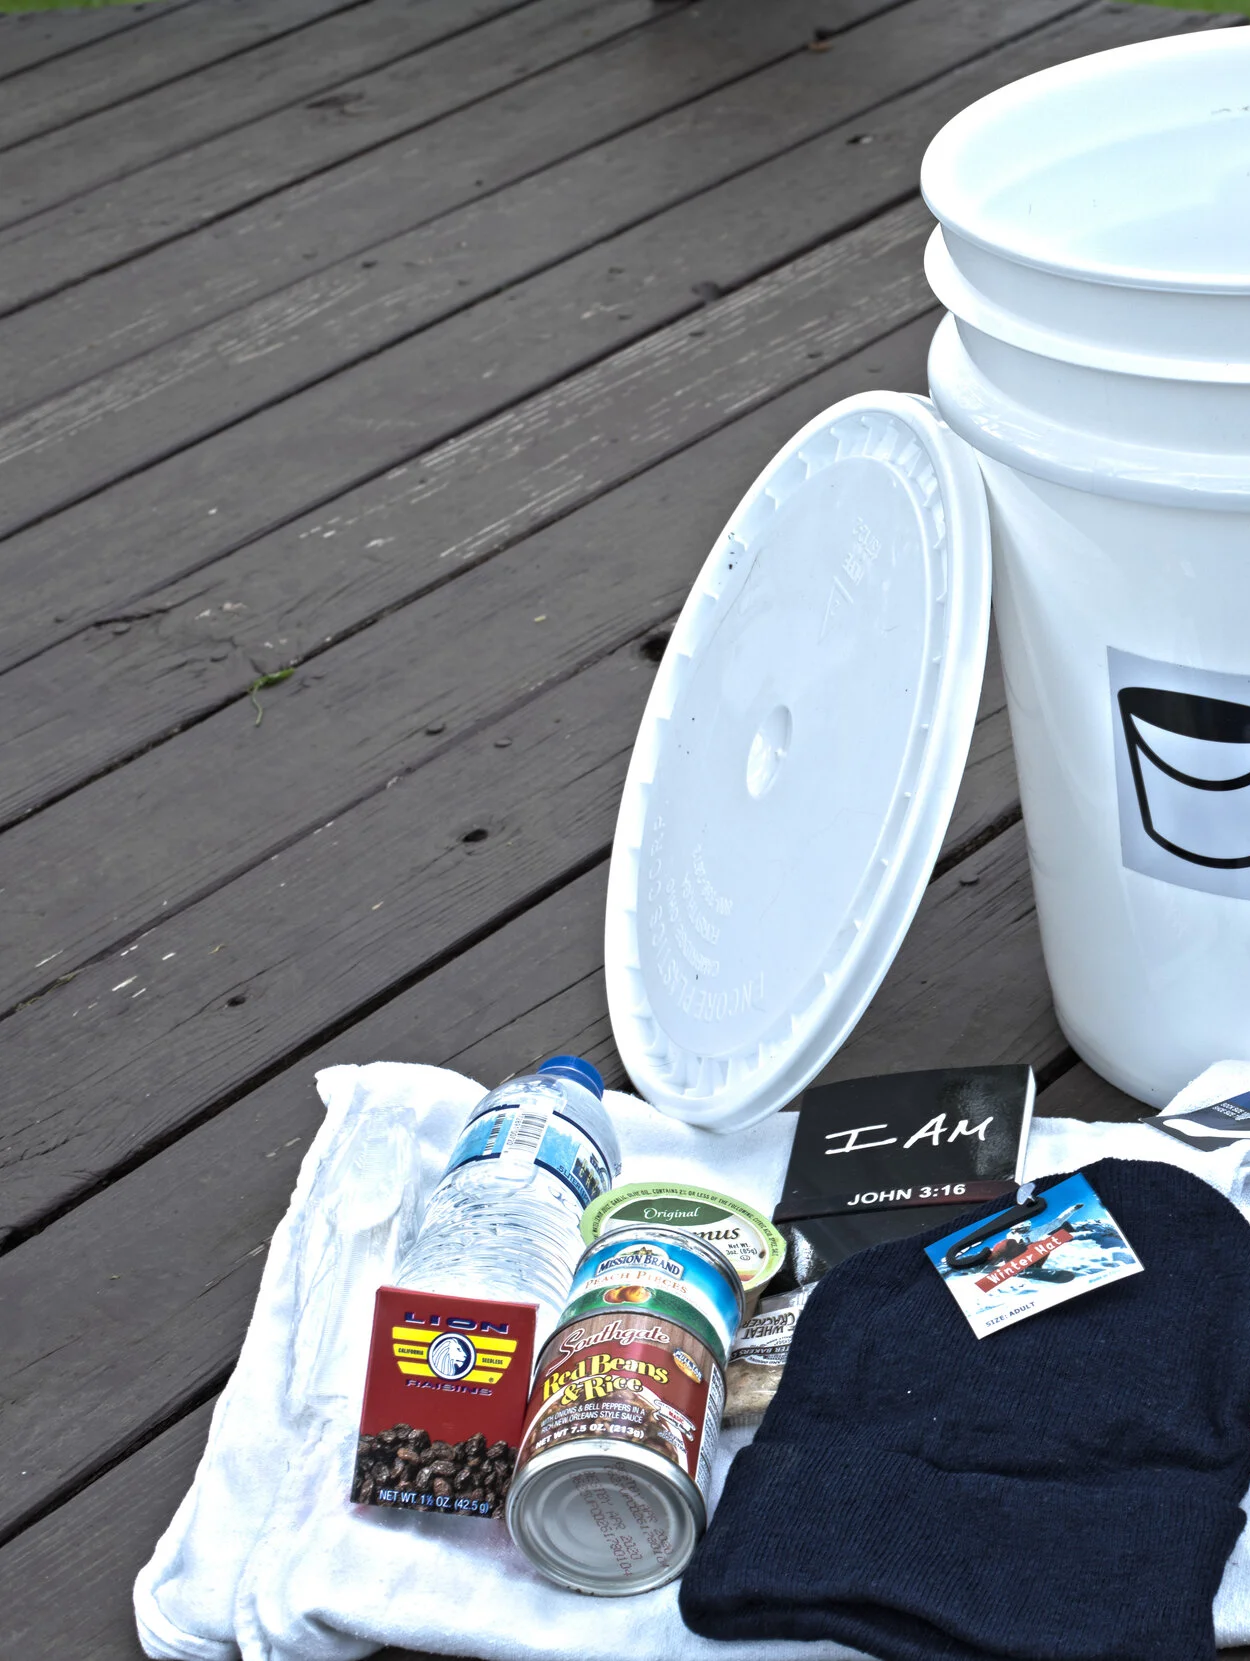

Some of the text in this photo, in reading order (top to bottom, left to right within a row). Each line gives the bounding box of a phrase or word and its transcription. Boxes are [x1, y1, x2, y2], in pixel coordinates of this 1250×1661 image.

[824, 1112, 994, 1155] I AM
[697, 1191, 709, 1200] LESS
[718, 1198, 728, 1206] THE
[847, 1184, 966, 1206] JOHN 3:16
[643, 1207, 701, 1222] Original
[740, 1248, 758, 1256] (85g)
[986, 1236, 1063, 1285] Winter Hat
[599, 1254, 681, 1277] MISSION BRAND
[585, 1270, 690, 1294] PEACH PIECES
[404, 1312, 509, 1335] LION
[742, 1312, 796, 1328] CRACKER
[985, 1314, 1008, 1328] SIZE:
[1009, 1301, 1036, 1317] ADULT
[740, 1325, 784, 1340] WHEAT
[398, 1347, 504, 1365] CALIFORNIA SEEDLESS
[547, 1320, 670, 1376] Southgate
[405, 1379, 493, 1396] RAISINS
[543, 1354, 669, 1401] Red Beans
[561, 1375, 643, 1405] & Rice
[541, 1413, 554, 1427] WITH
[554, 1406, 577, 1421] ONIONS
[584, 1403, 600, 1412] BELL
[601, 1402, 631, 1412] PEPPERS
[640, 1407, 646, 1415] A
[554, 1416, 569, 1429] NEW
[569, 1411, 598, 1424] ORLEANS
[599, 1410, 620, 1420] STYLE
[621, 1412, 643, 1424] SAUCE
[535, 1423, 645, 1450] NET WT 7.5 OZ. (213g)
[379, 1490, 398, 1502] NET
[401, 1491, 416, 1504] WT.
[435, 1496, 452, 1508] OZ.
[454, 1497, 478, 1512] (42.5
[479, 1501, 490, 1514] g)
[606, 1508, 625, 1530] APR
[620, 1532, 642, 1561] 2020
